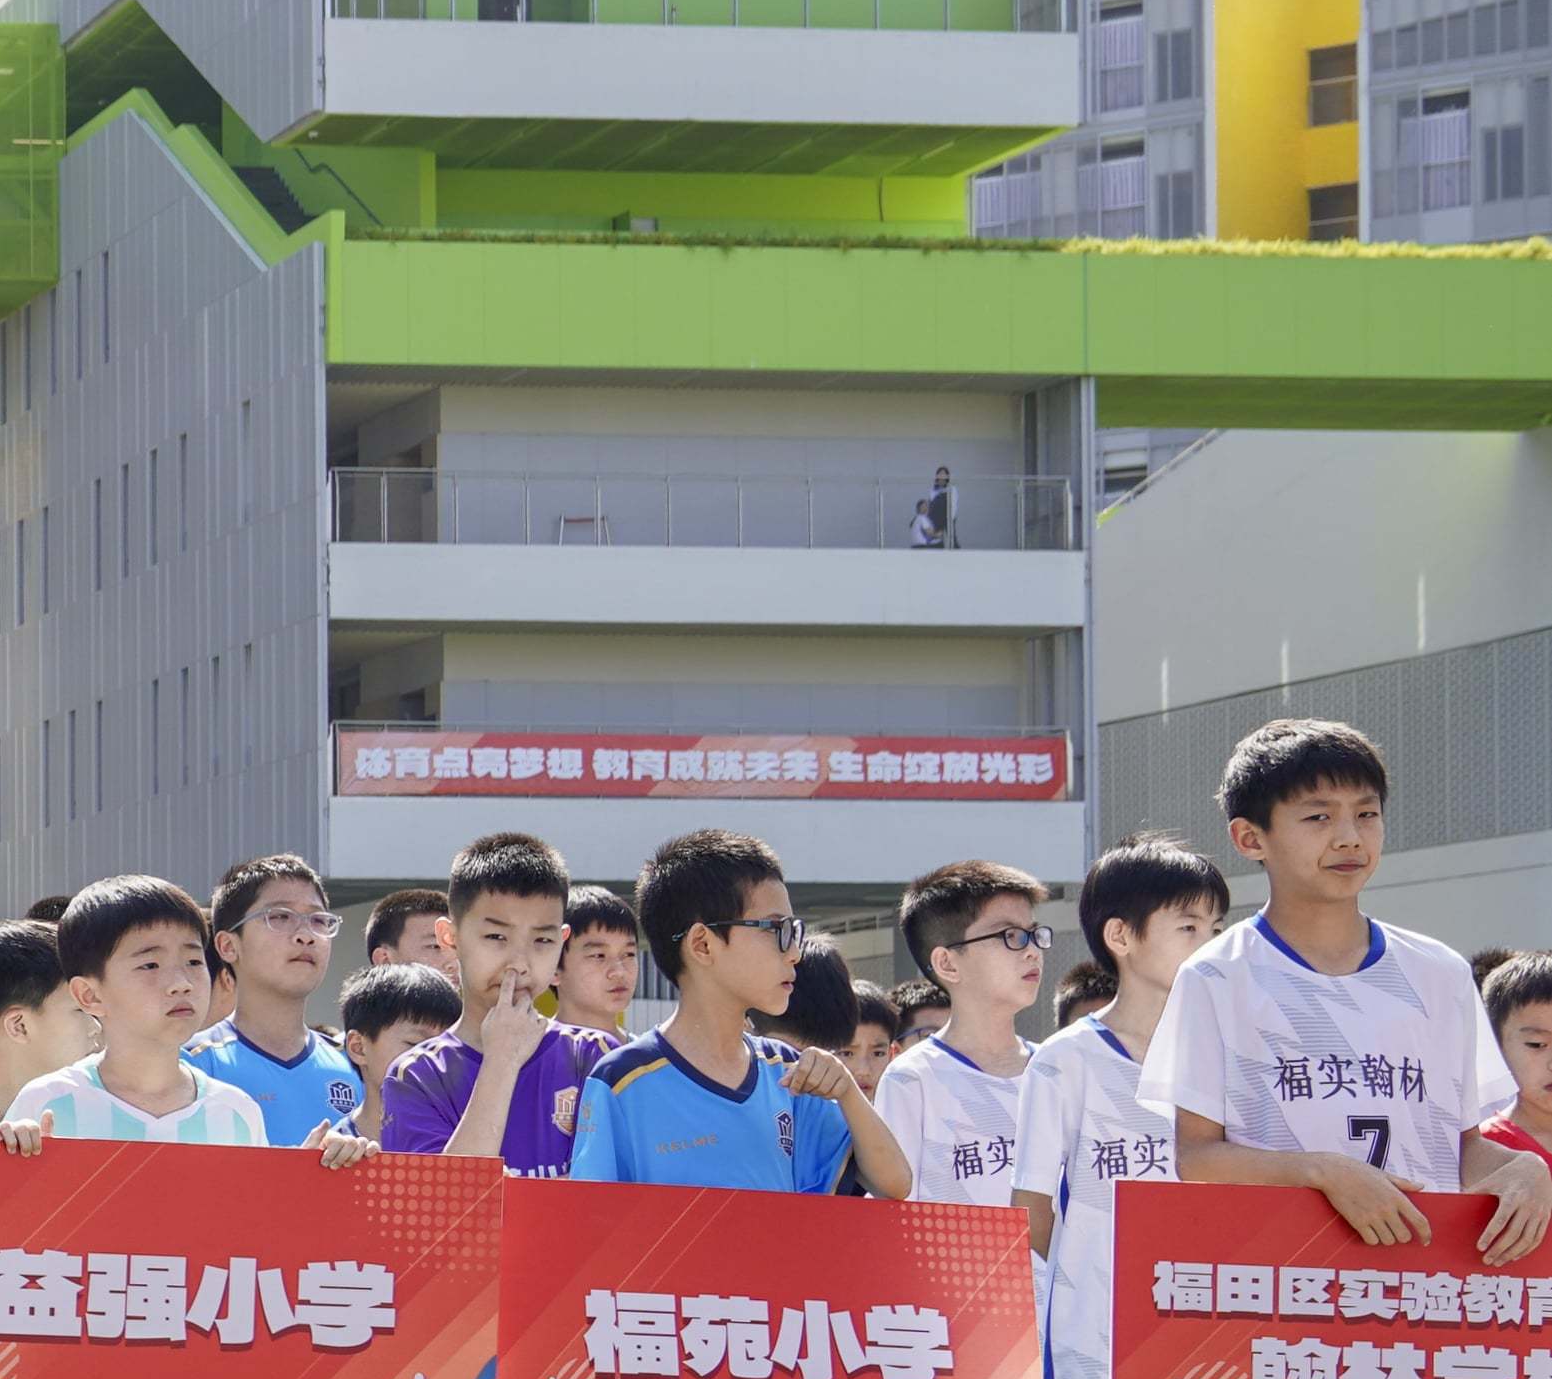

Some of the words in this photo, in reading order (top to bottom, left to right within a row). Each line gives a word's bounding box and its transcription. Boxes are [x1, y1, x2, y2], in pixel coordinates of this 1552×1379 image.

[355, 747, 584, 780] 体育点亮梦想
[593, 748, 820, 781] 教育成就未来
[828, 751, 1054, 784] 生命绽放光彩
[1273, 1054, 1428, 1102] 福实翰林
[1092, 1134, 1169, 1181] 福实
[1346, 1115, 1391, 1170] 7
